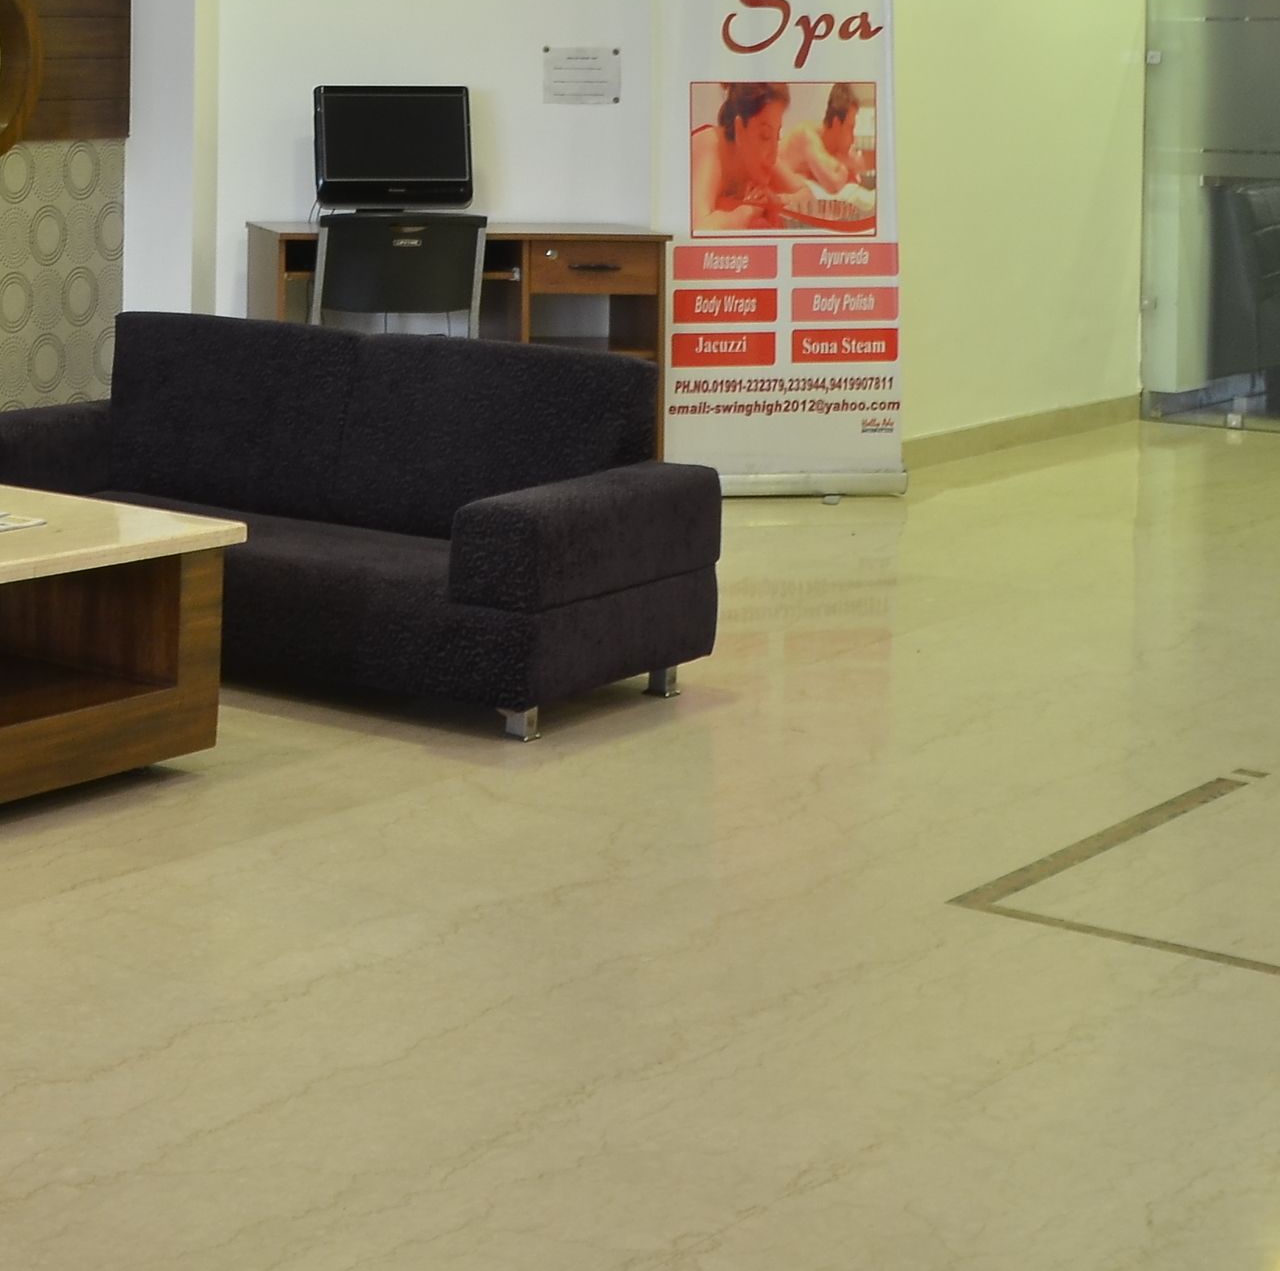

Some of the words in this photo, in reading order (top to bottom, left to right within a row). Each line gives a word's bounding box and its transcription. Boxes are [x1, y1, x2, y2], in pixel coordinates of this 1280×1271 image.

[703, 252, 749, 273] Massage
[819, 247, 869, 269] Ayurveda
[695, 295, 721, 316] Body
[723, 294, 757, 316] Wraps
[812, 294, 840, 315] Body
[842, 293, 875, 311] Polish
[695, 335, 747, 353] Jacuzzi
[802, 337, 837, 354] Sona
[841, 336, 886, 354] Steam
